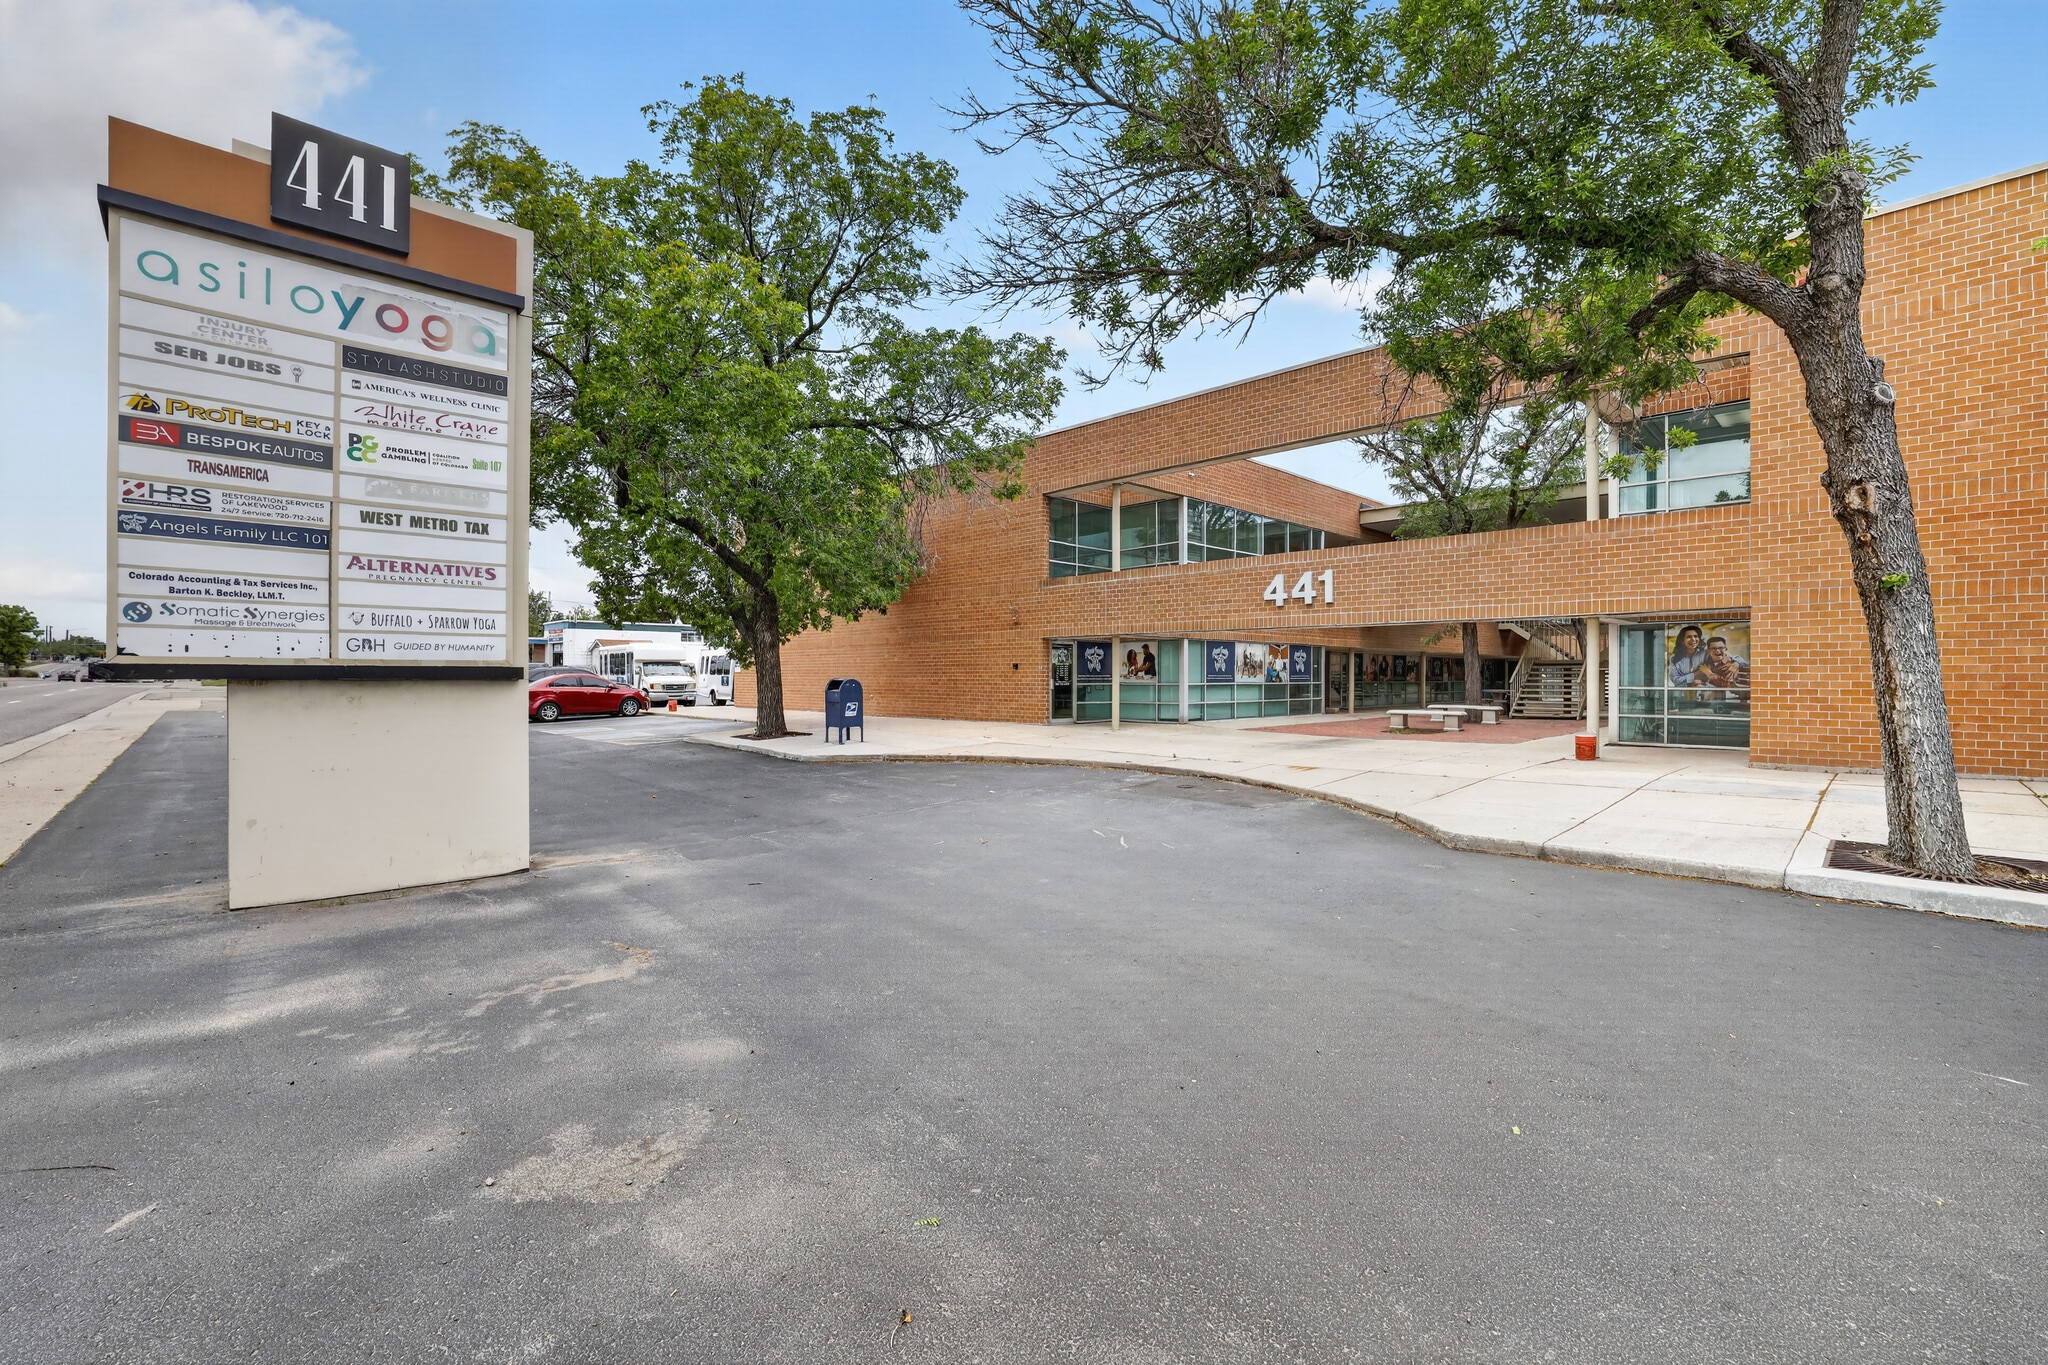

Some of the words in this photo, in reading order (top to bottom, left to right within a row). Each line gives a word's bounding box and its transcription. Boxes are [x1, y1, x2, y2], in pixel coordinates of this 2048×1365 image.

[286, 140, 398, 232] 441
[197, 325, 268, 346] CENTER
[200, 316, 266, 336] INJURY
[154, 341, 208, 362] SER
[215, 354, 282, 376] JOBS
[363, 383, 416, 398] AMERICA'S
[420, 392, 468, 407] WELLNESS
[471, 401, 501, 413] CLINIC
[296, 419, 319, 430] KEY
[354, 405, 426, 425] White
[435, 414, 498, 435] Crane
[367, 418, 442, 434] medicine
[459, 430, 487, 440] inc.
[297, 428, 331, 440] LOCK
[381, 452, 427, 464] GAMBLING
[385, 446, 427, 457] PROBLEM
[187, 459, 269, 482] TRANSAMERICA
[472, 458, 489, 471] Suite
[490, 461, 502, 472] 107
[148, 483, 212, 505] HRS
[221, 492, 283, 505] RESTORATION
[285, 499, 325, 509] SERVICES
[236, 500, 288, 511] LAKEWOOD
[241, 509, 274, 518] Service:
[274, 512, 324, 523] 720-712-2416
[360, 510, 403, 526] WEST
[409, 515, 458, 532] METRO
[464, 521, 489, 535] TAX
[149, 519, 208, 535] Angels
[214, 525, 267, 542] Family
[272, 530, 298, 542] LLC
[304, 533, 328, 545] 101
[128, 571, 175, 582] Colorado
[177, 574, 231, 587] Accounting
[233, 578, 241, 586] &
[243, 579, 258, 587] Tax
[260, 580, 298, 589] Services
[368, 573, 437, 583] PREGNANCY
[443, 578, 483, 586] CENTER
[1263, 569, 1334, 607] 441
[168, 586, 202, 596] Barton
[204, 588, 214, 596] K.
[216, 589, 255, 600] Beckley,
[159, 602, 240, 618] Somatic
[243, 606, 325, 623] Synergies
[194, 618, 236, 628] Massage
[246, 620, 297, 628] Breathwork
[433, 643, 446, 651] BY
[448, 643, 495, 652] HUMANITY
